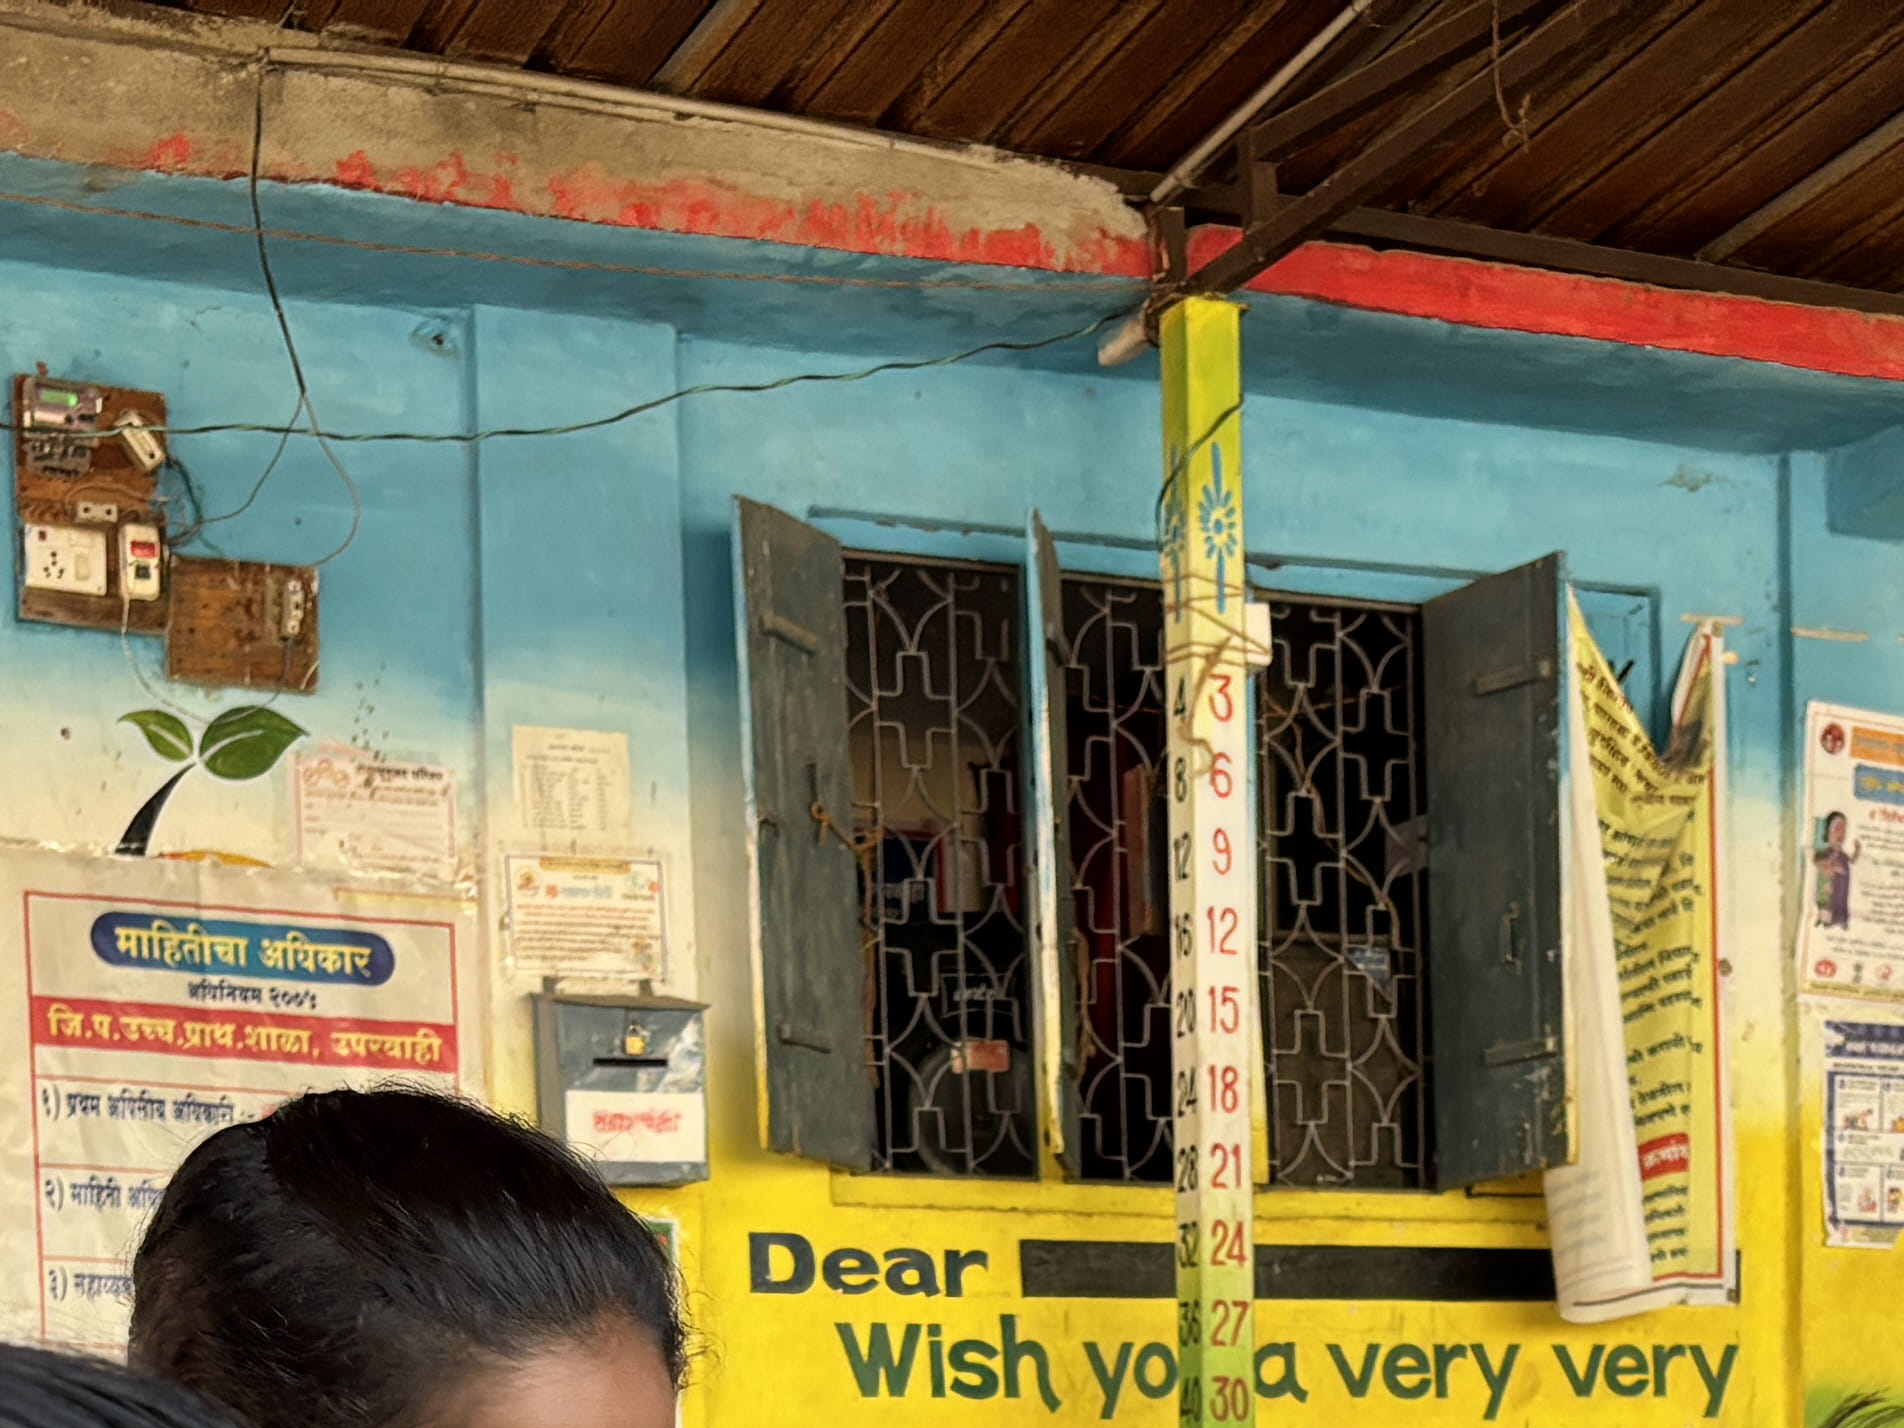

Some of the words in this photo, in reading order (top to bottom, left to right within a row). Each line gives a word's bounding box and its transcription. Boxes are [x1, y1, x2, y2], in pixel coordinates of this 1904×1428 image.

[1173, 677, 1186, 716] 4
[1208, 675, 1233, 722] 3
[1174, 757, 1187, 802] 8
[1211, 752, 1233, 798] 6
[1173, 832, 1192, 880] 12
[1212, 828, 1232, 875] 9
[114, 919, 248, 968] माहितीचा
[259, 930, 372, 978] अधिकार
[1207, 907, 1238, 955] 12
[1177, 988, 1195, 1038] 20
[1208, 986, 1239, 1034] 15
[1178, 1066, 1198, 1117] 24
[1207, 1064, 1239, 1115] 18
[1178, 1145, 1199, 1192] 28
[1210, 1143, 1242, 1190] 21
[70, 1174, 122, 1213] माहिती
[747, 1231, 989, 1298] Dear
[1179, 1221, 1199, 1268] 32
[1210, 1220, 1247, 1268] 24
[1179, 1299, 1201, 1346] 36
[1211, 1300, 1249, 1347] 27
[833, 1313, 1062, 1413] Wish
[1082, 1340, 1177, 1420] yo
[1254, 1340, 1309, 1402] a
[1327, 1340, 1522, 1420] very
[1552, 1342, 1739, 1419] very
[1210, 1376, 1249, 1422] 30
